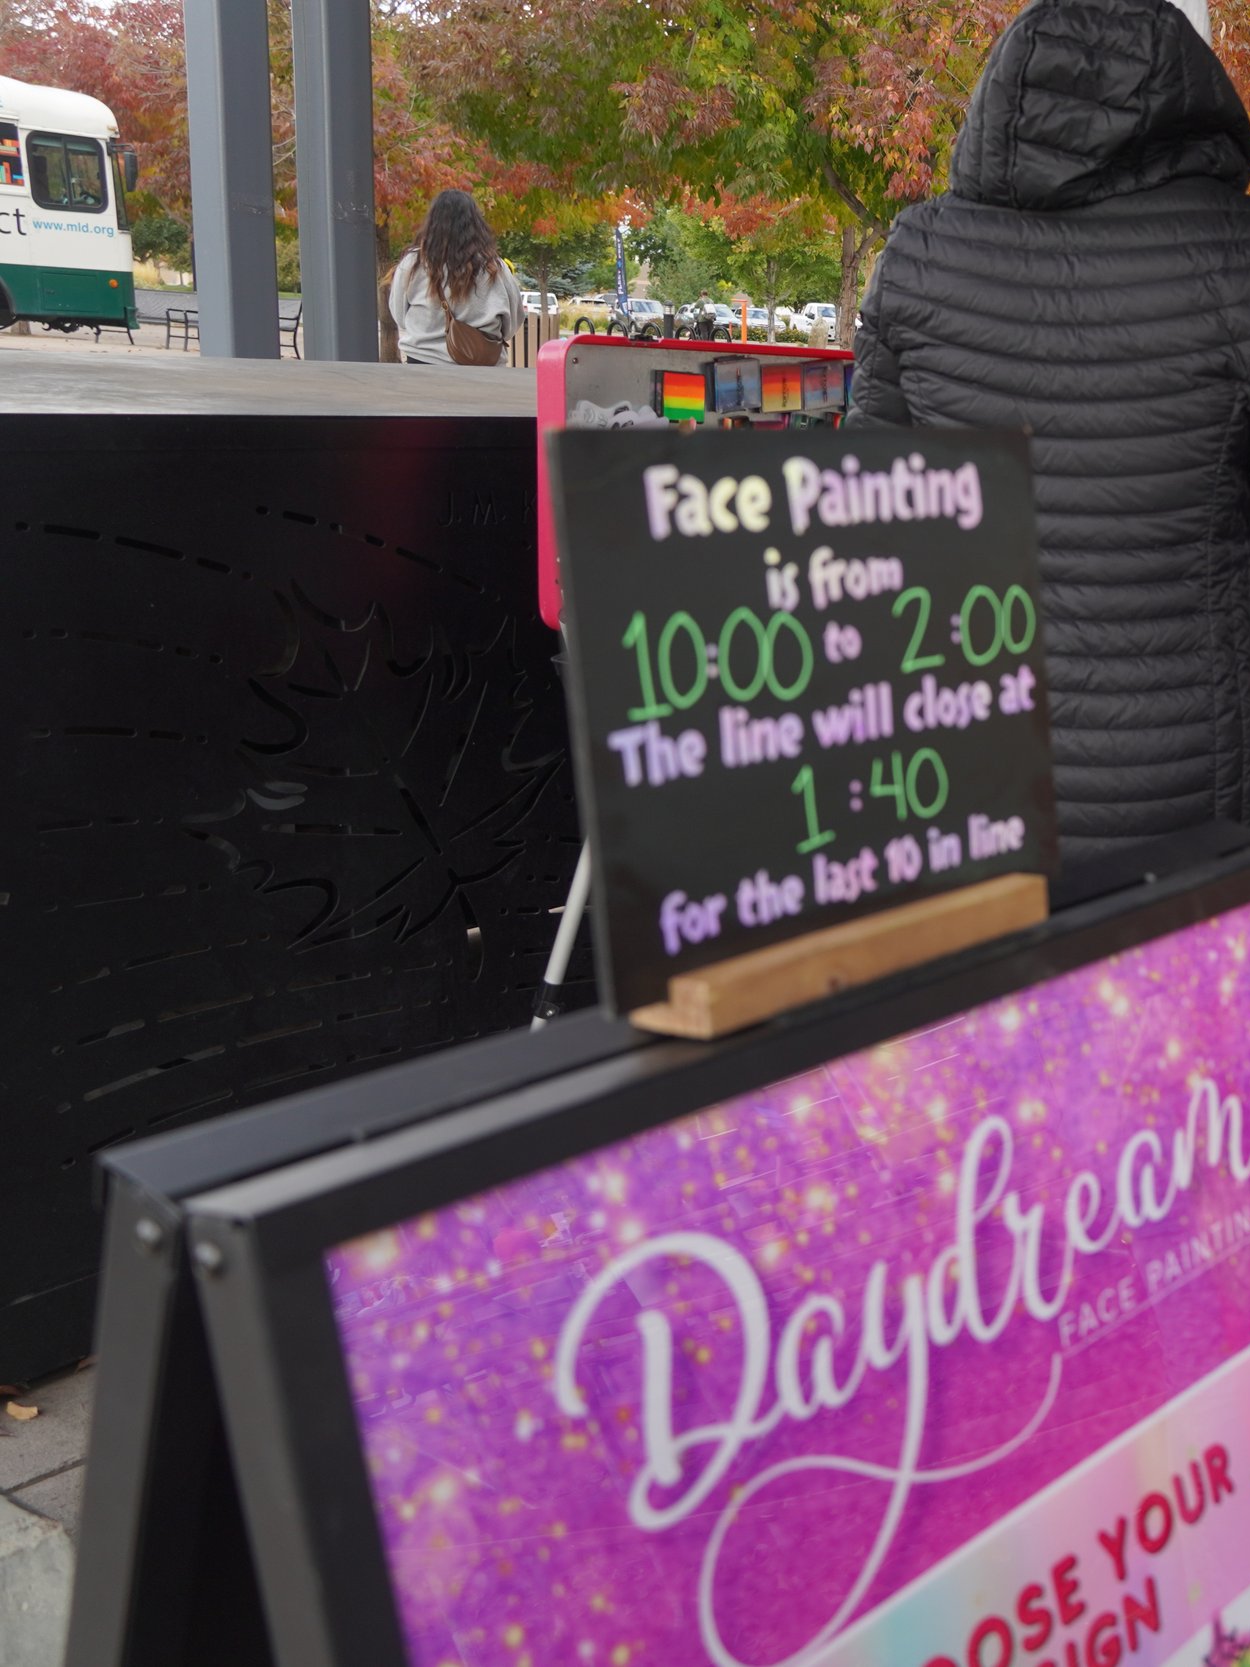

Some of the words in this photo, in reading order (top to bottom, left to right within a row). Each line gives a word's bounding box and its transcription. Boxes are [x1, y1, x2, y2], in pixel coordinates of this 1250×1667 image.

[33, 220, 115, 238] www.mld.org
[643, 464, 773, 541] Face
[783, 453, 984, 536] Painting
[764, 547, 799, 611] is
[808, 546, 904, 611] from
[622, 606, 814, 722] 10:00
[824, 620, 862, 663] to
[892, 584, 1036, 674] 2:00
[607, 722, 706, 787] The
[718, 706, 804, 768] line
[812, 681, 893, 748] will
[903, 674, 992, 732] close
[999, 663, 1036, 715] at
[659, 890, 728, 955] for
[736, 868, 804, 926] the
[813, 847, 879, 905] last
[884, 835, 922, 883] 10
[927, 827, 962, 872] in
[967, 814, 1025, 861] line
[1057, 1275, 1137, 1350] FACE
[920, 1553, 1086, 1667] OSE
[1097, 1444, 1235, 1583] YOUR
